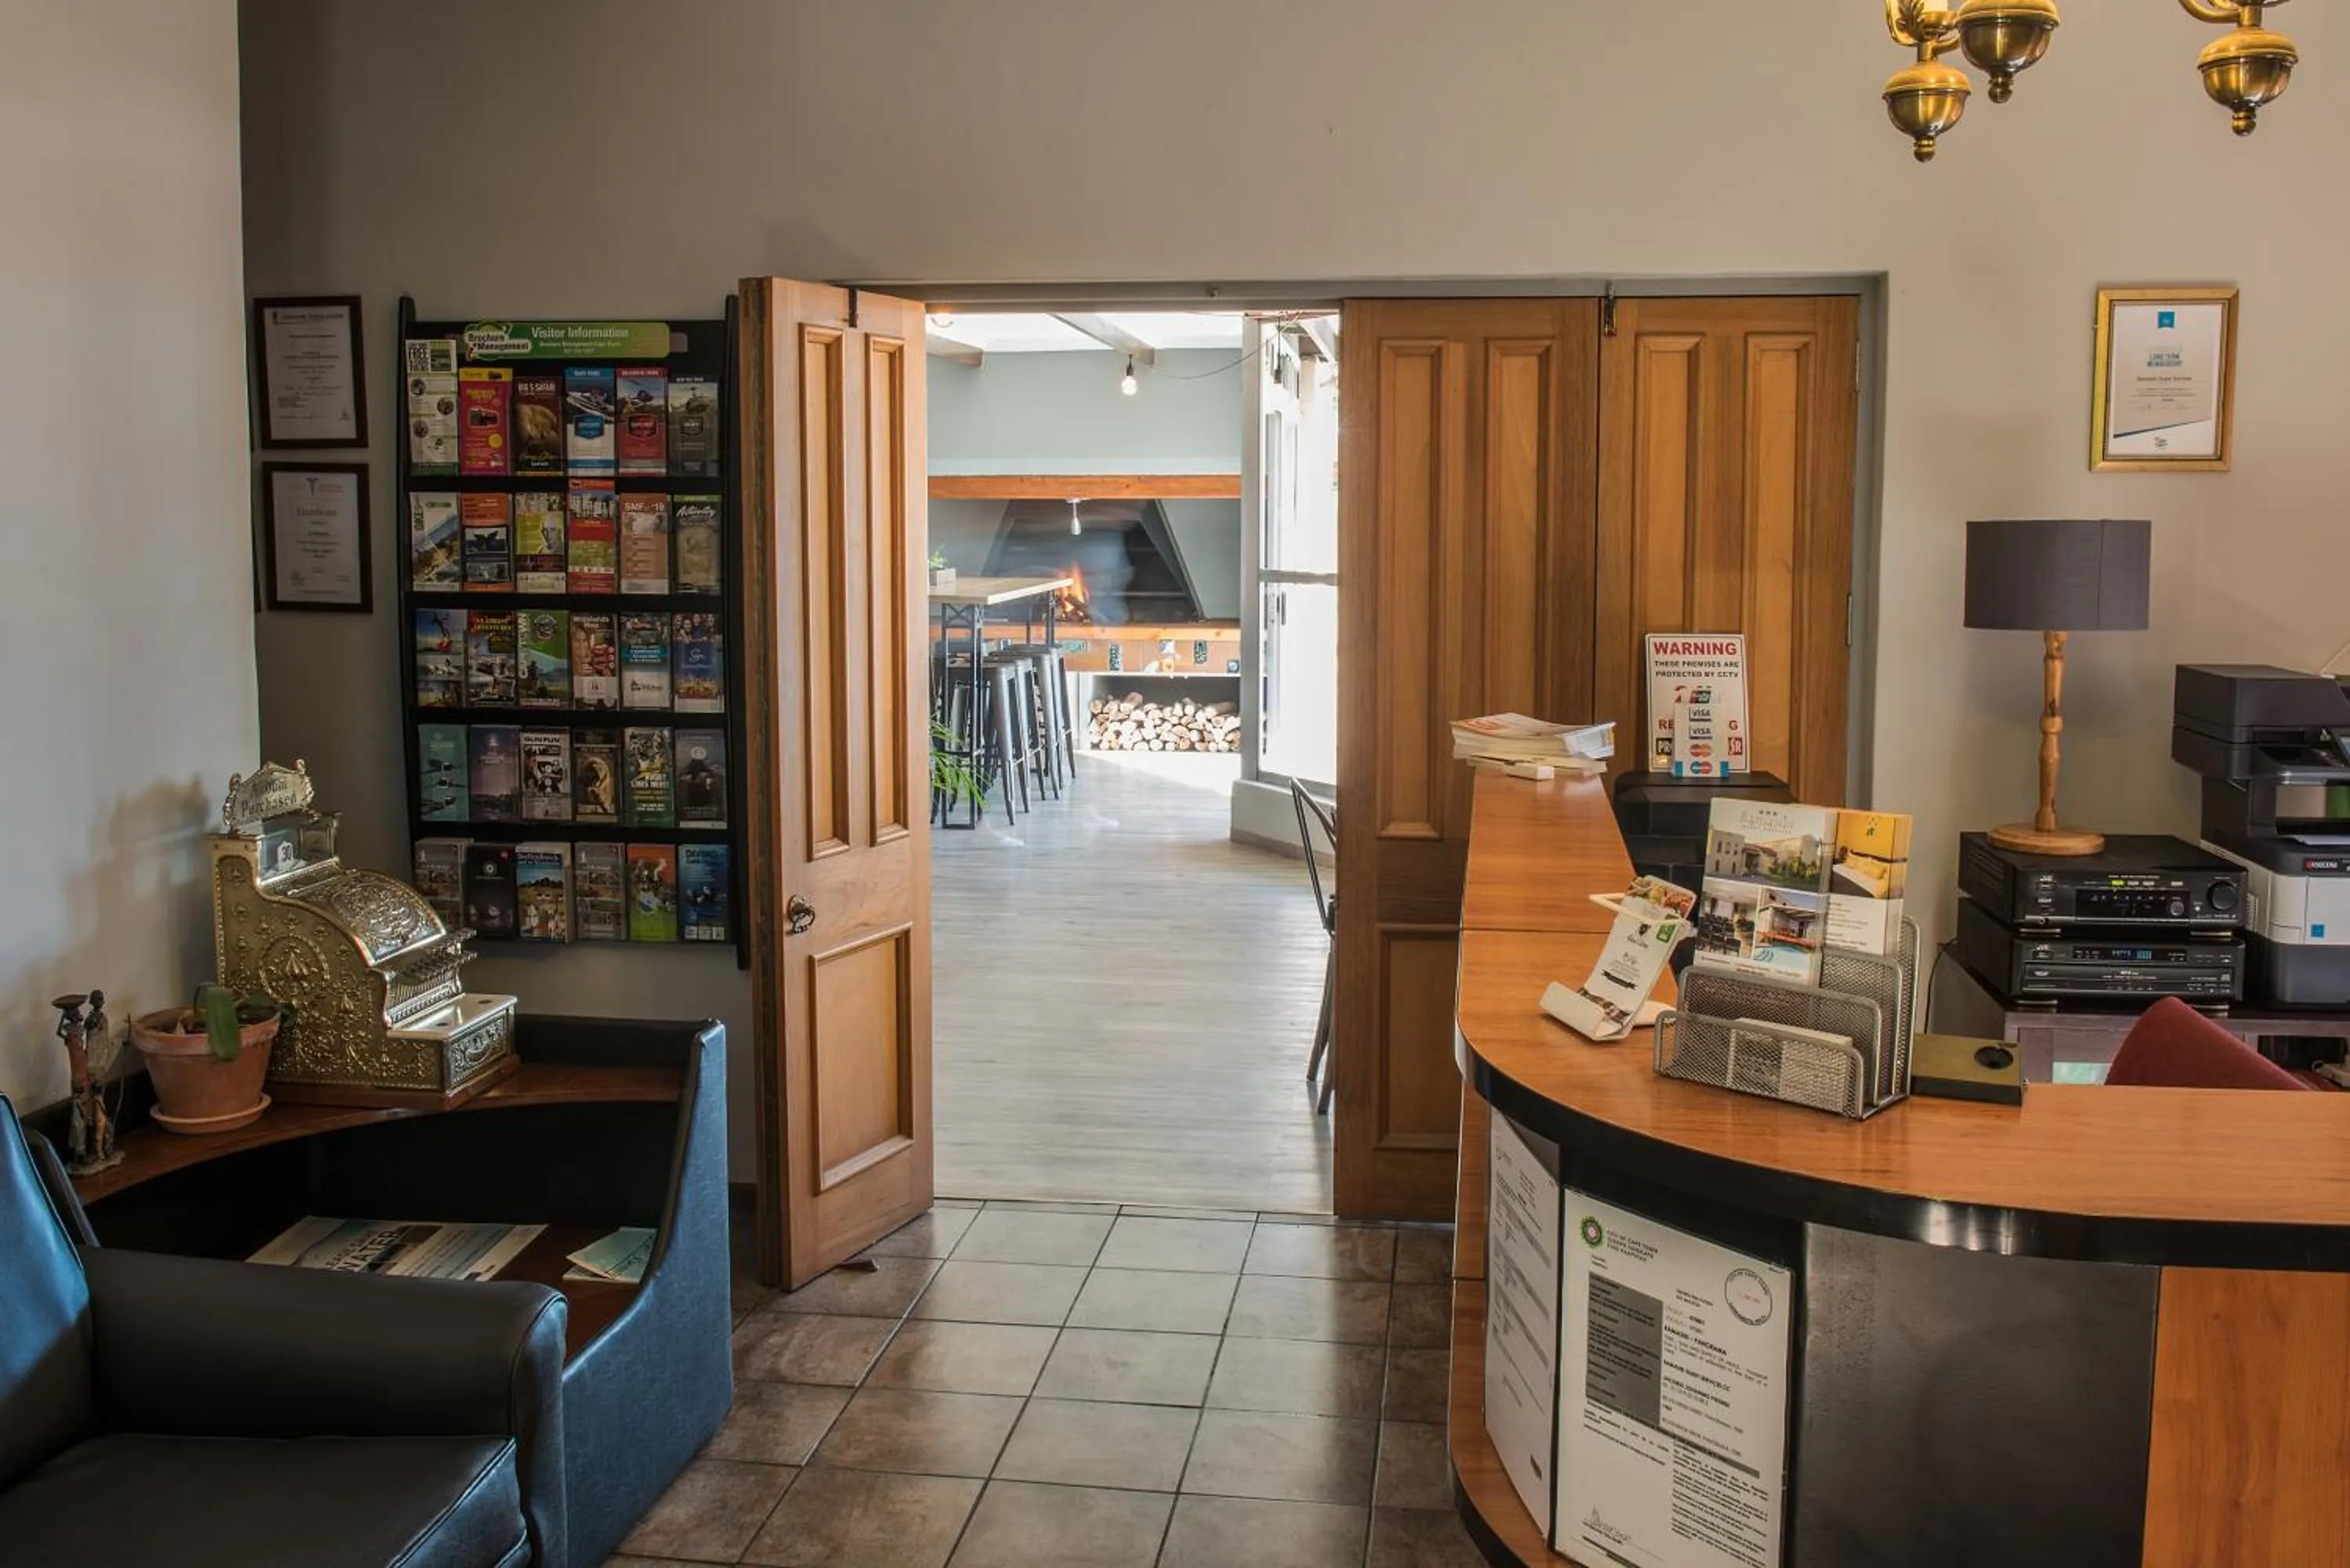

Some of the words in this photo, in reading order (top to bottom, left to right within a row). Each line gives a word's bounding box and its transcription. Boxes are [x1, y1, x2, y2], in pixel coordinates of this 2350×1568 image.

[531, 326, 566, 338] Visitor
[568, 326, 629, 338] Information
[1654, 641, 1737, 656] WARNING
